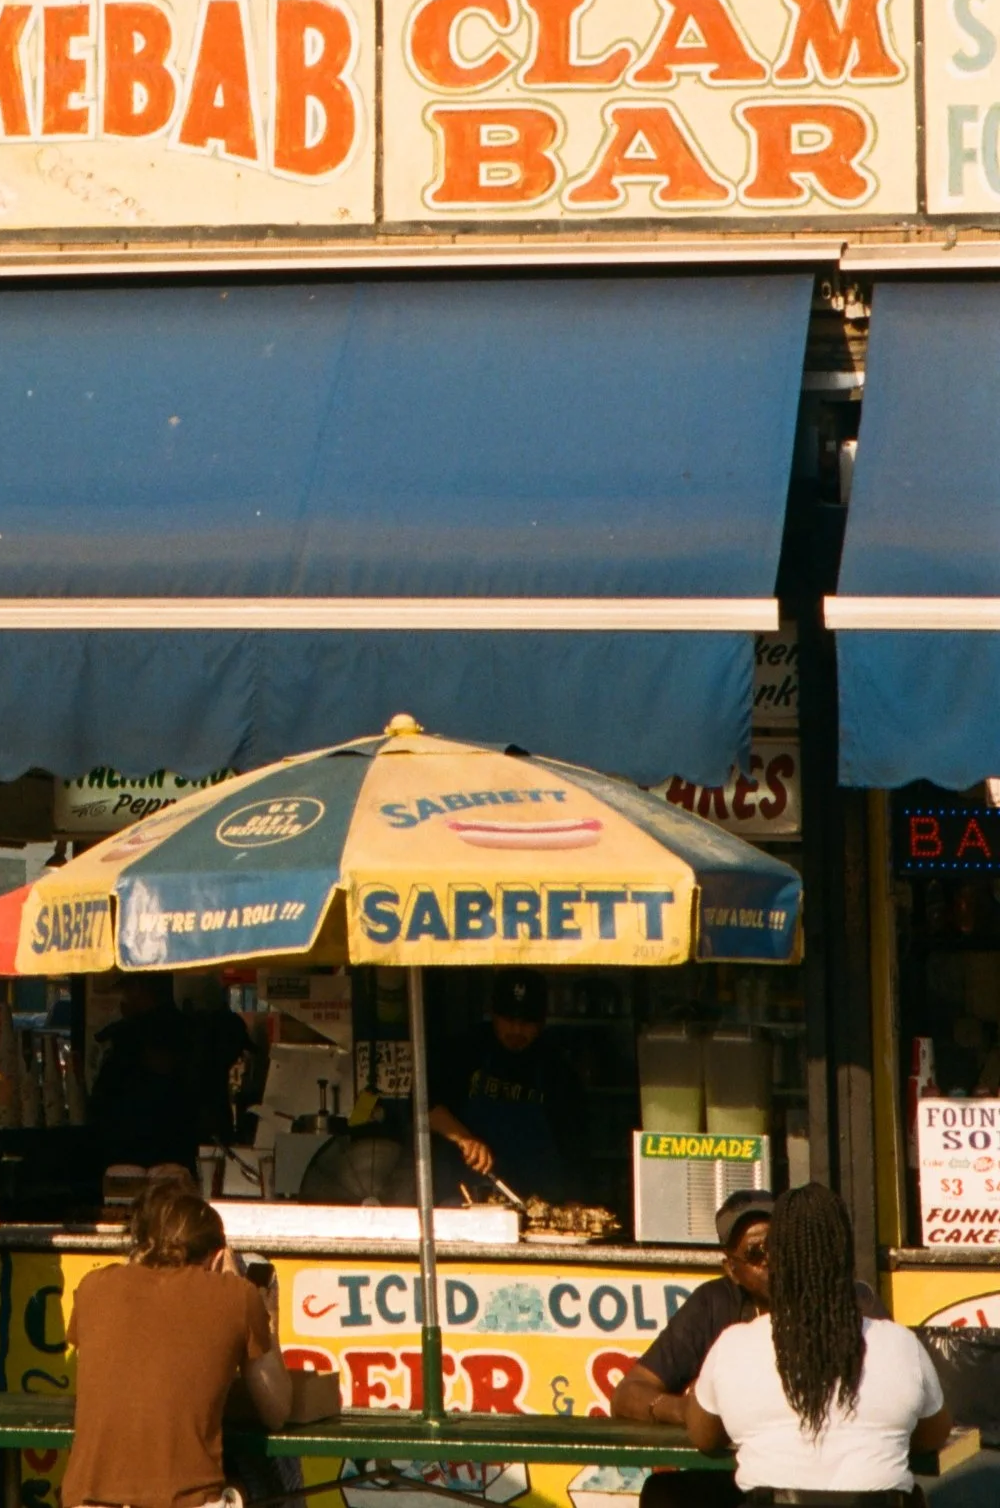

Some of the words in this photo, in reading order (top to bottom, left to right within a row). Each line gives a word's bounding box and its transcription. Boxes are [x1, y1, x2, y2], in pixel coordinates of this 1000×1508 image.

[424, 98, 876, 208] BAR
[380, 788, 568, 829] SABRETT
[31, 898, 110, 955] SABRETT
[139, 912, 196, 934] WE'RE
[201, 910, 227, 931] ON
[227, 908, 239, 929] A
[241, 904, 277, 928] ROLL
[362, 886, 674, 944] SABRETT
[632, 944, 664, 959] 2017
[926, 1107, 1000, 1128] FOUN
[646, 1134, 757, 1159] LEMONADE
[942, 1130, 1000, 1150] SO
[940, 1178, 964, 1196] $3
[926, 1207, 1000, 1224] FUNN
[927, 1228, 1000, 1244] CAKE
